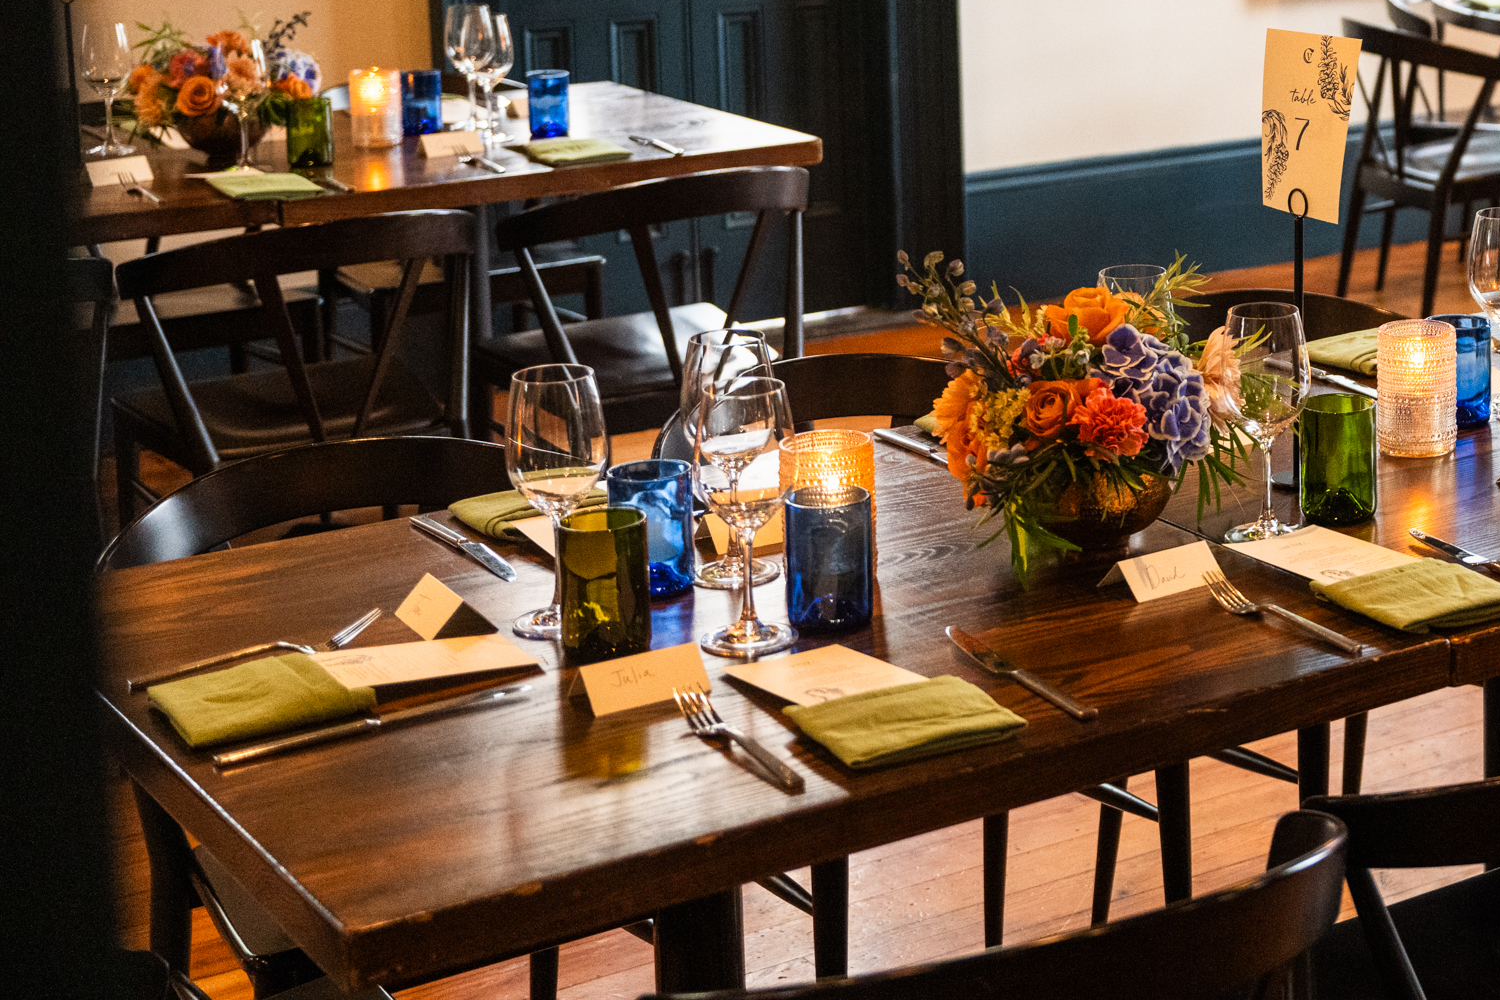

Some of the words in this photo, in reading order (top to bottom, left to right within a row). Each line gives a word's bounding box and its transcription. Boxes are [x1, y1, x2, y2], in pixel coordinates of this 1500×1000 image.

[1289, 87, 1317, 106] table
[1294, 116, 1311, 151] 7
[1145, 564, 1186, 591] David
[608, 666, 656, 688] Julia
